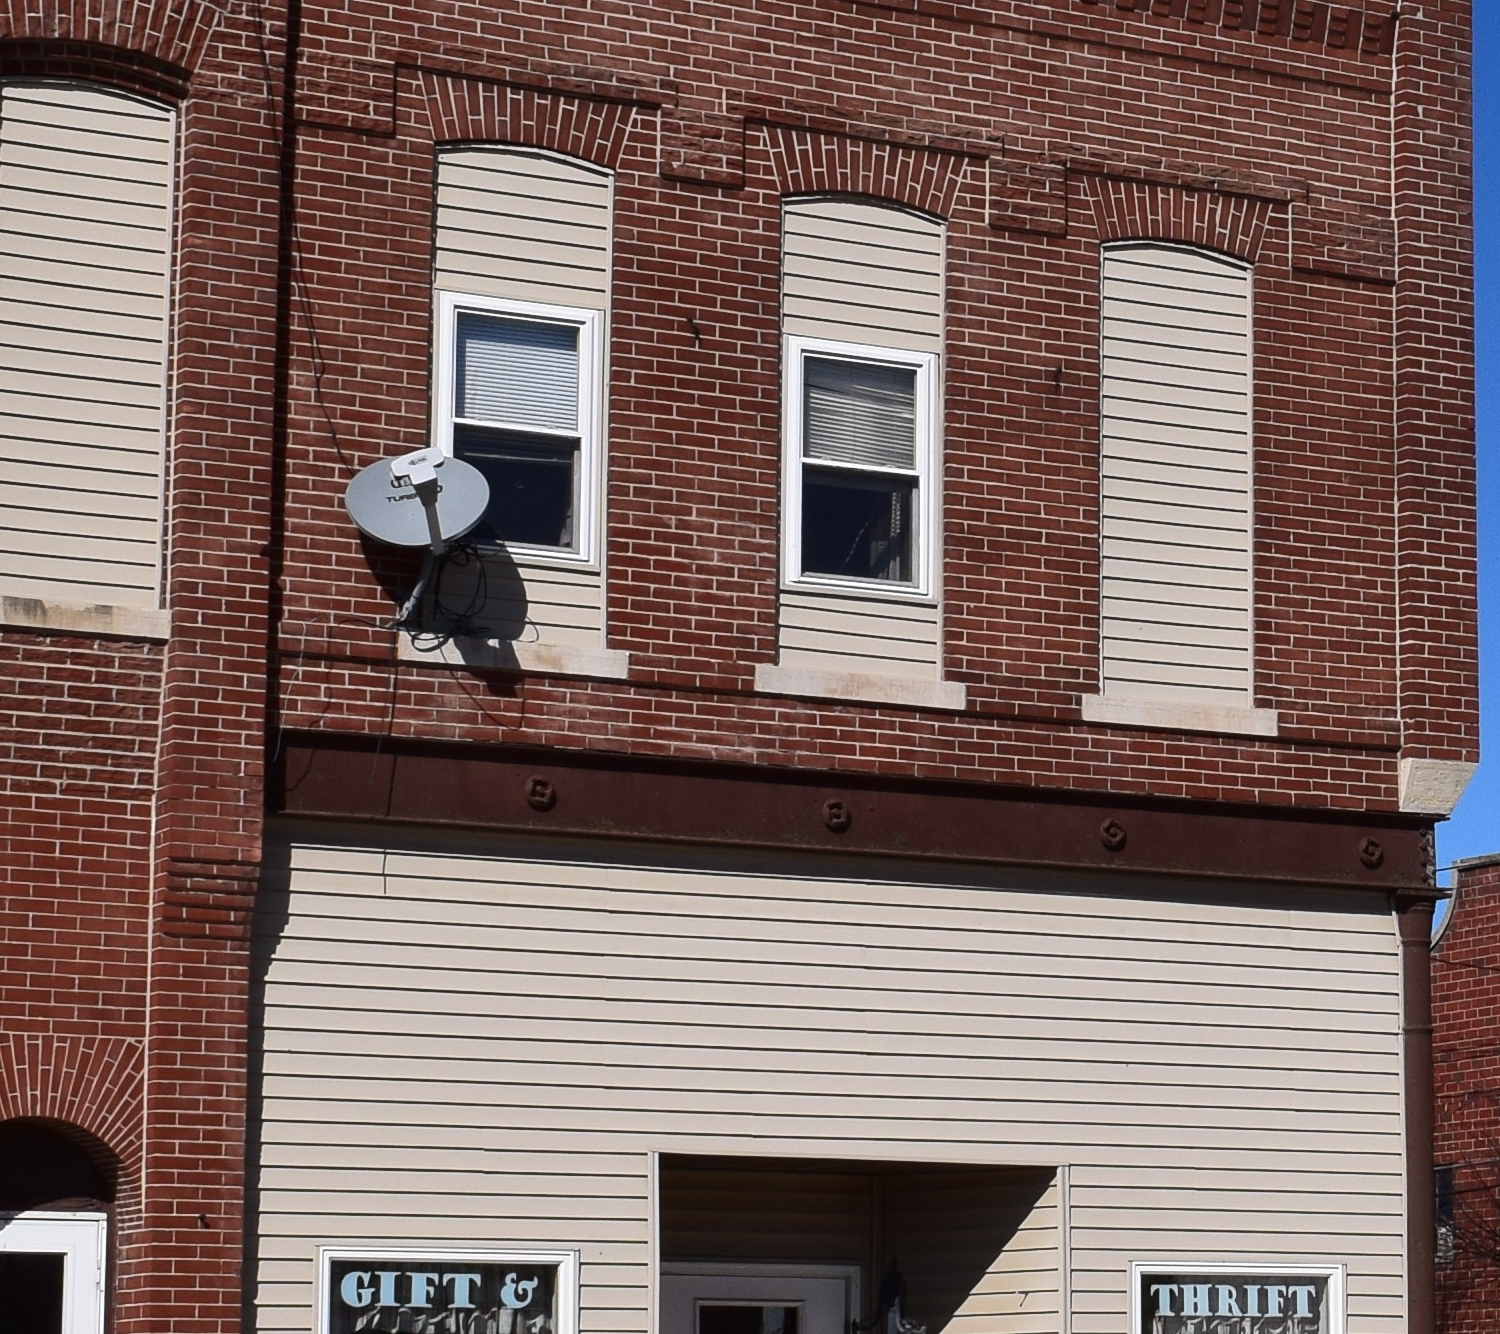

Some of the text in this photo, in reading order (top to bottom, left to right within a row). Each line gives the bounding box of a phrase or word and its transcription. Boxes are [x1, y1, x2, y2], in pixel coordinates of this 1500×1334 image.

[341, 1271, 538, 1309] GIFT &
[1150, 1284, 1316, 1318] THRIFT
